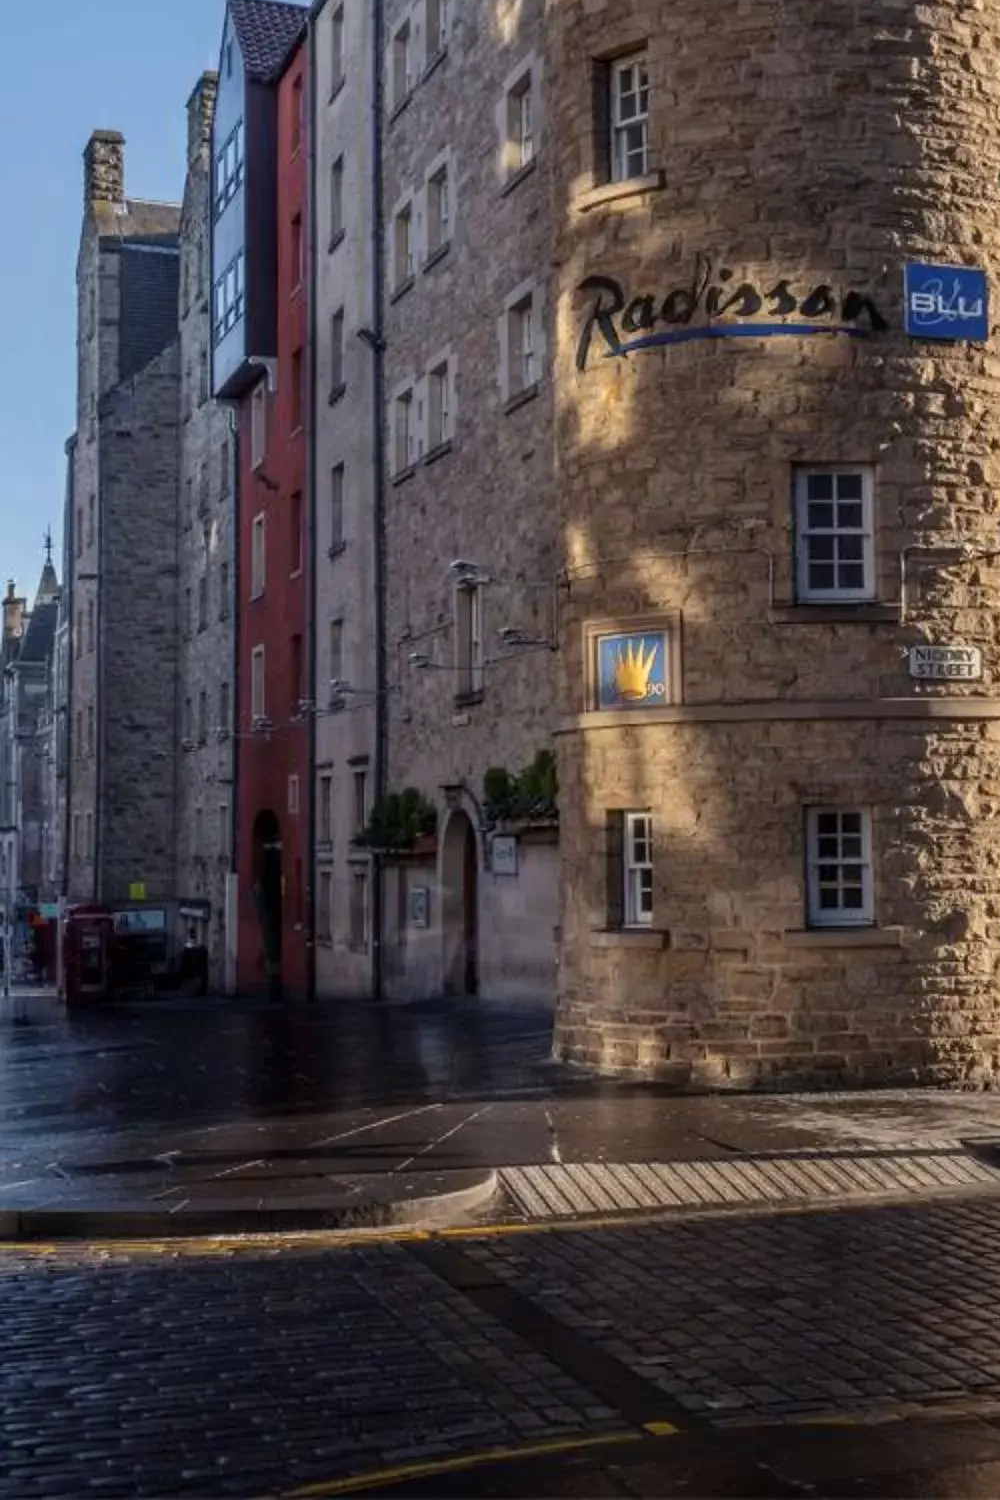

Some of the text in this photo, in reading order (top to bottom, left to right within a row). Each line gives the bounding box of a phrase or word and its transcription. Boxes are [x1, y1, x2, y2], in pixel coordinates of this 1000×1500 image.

[575, 250, 983, 373] Radisson BLU
[916, 664, 975, 676] STREET
